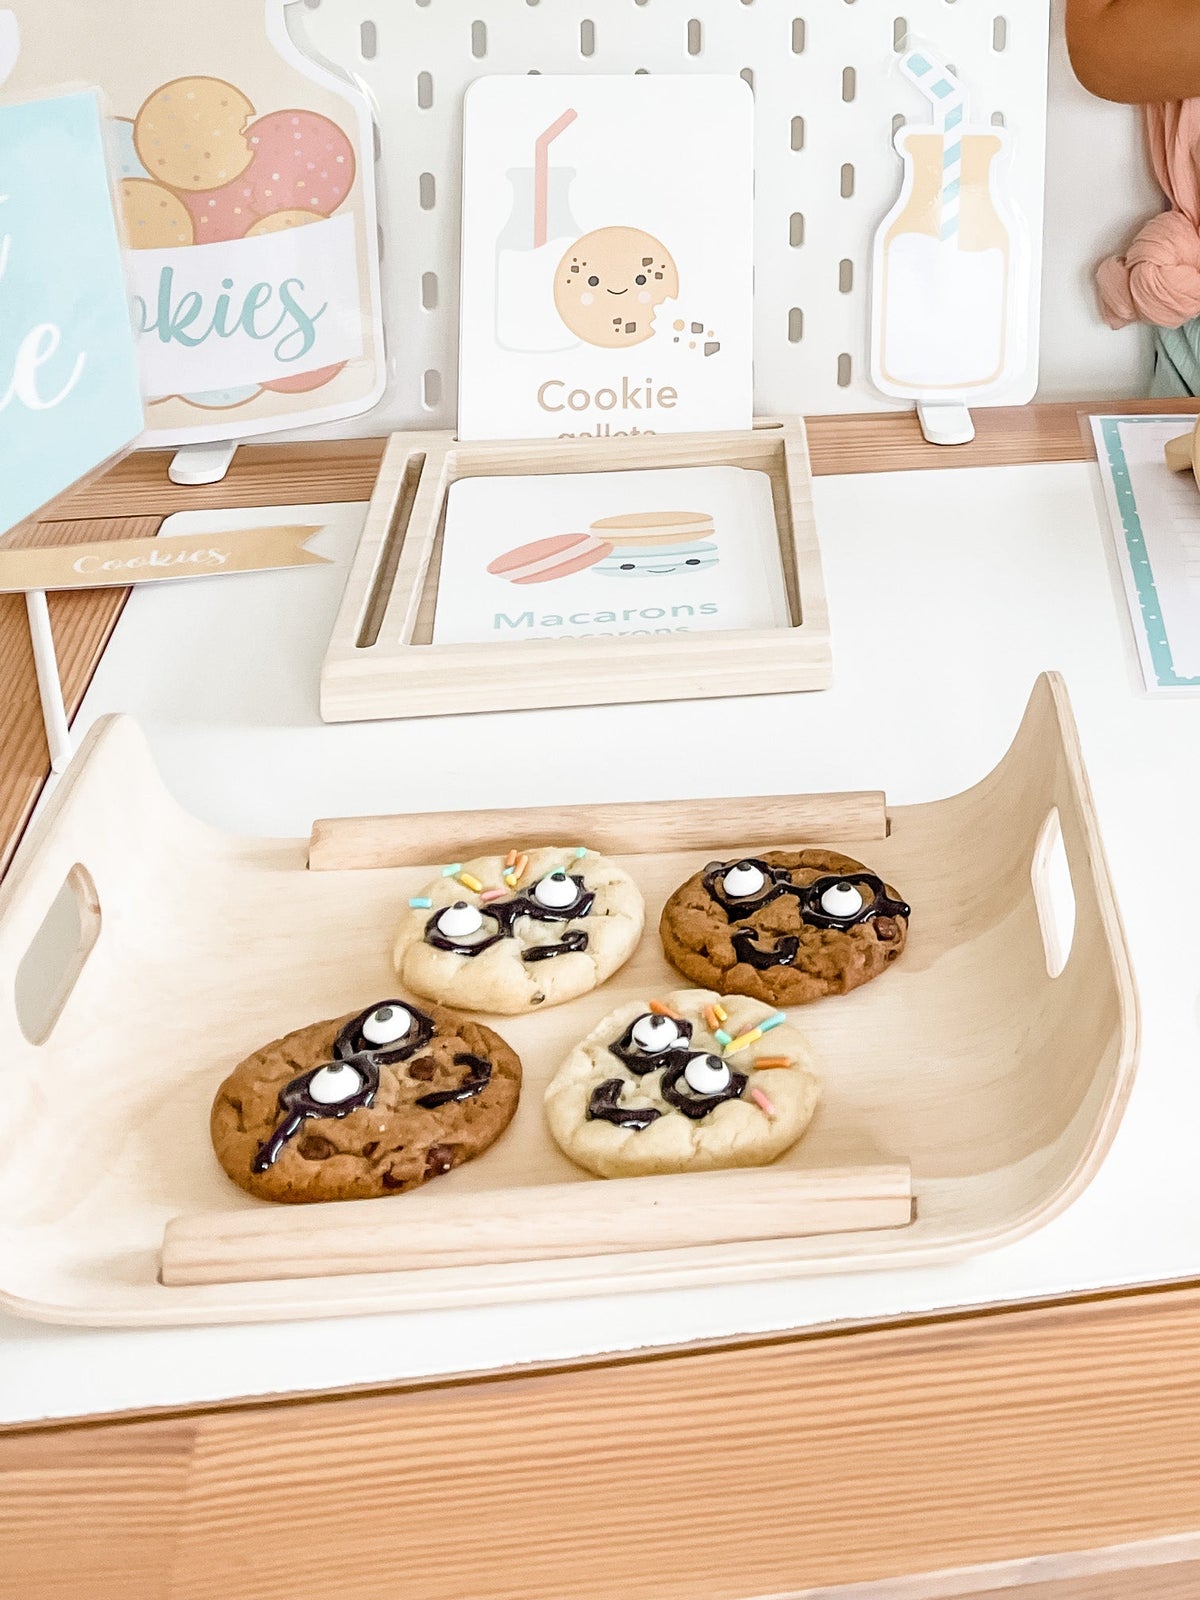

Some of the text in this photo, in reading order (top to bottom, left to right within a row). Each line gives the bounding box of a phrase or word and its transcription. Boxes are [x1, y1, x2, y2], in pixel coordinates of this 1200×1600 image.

[537, 376, 678, 412] Cookie
[73, 548, 232, 574] Cookies
[493, 602, 719, 629] Macarons
